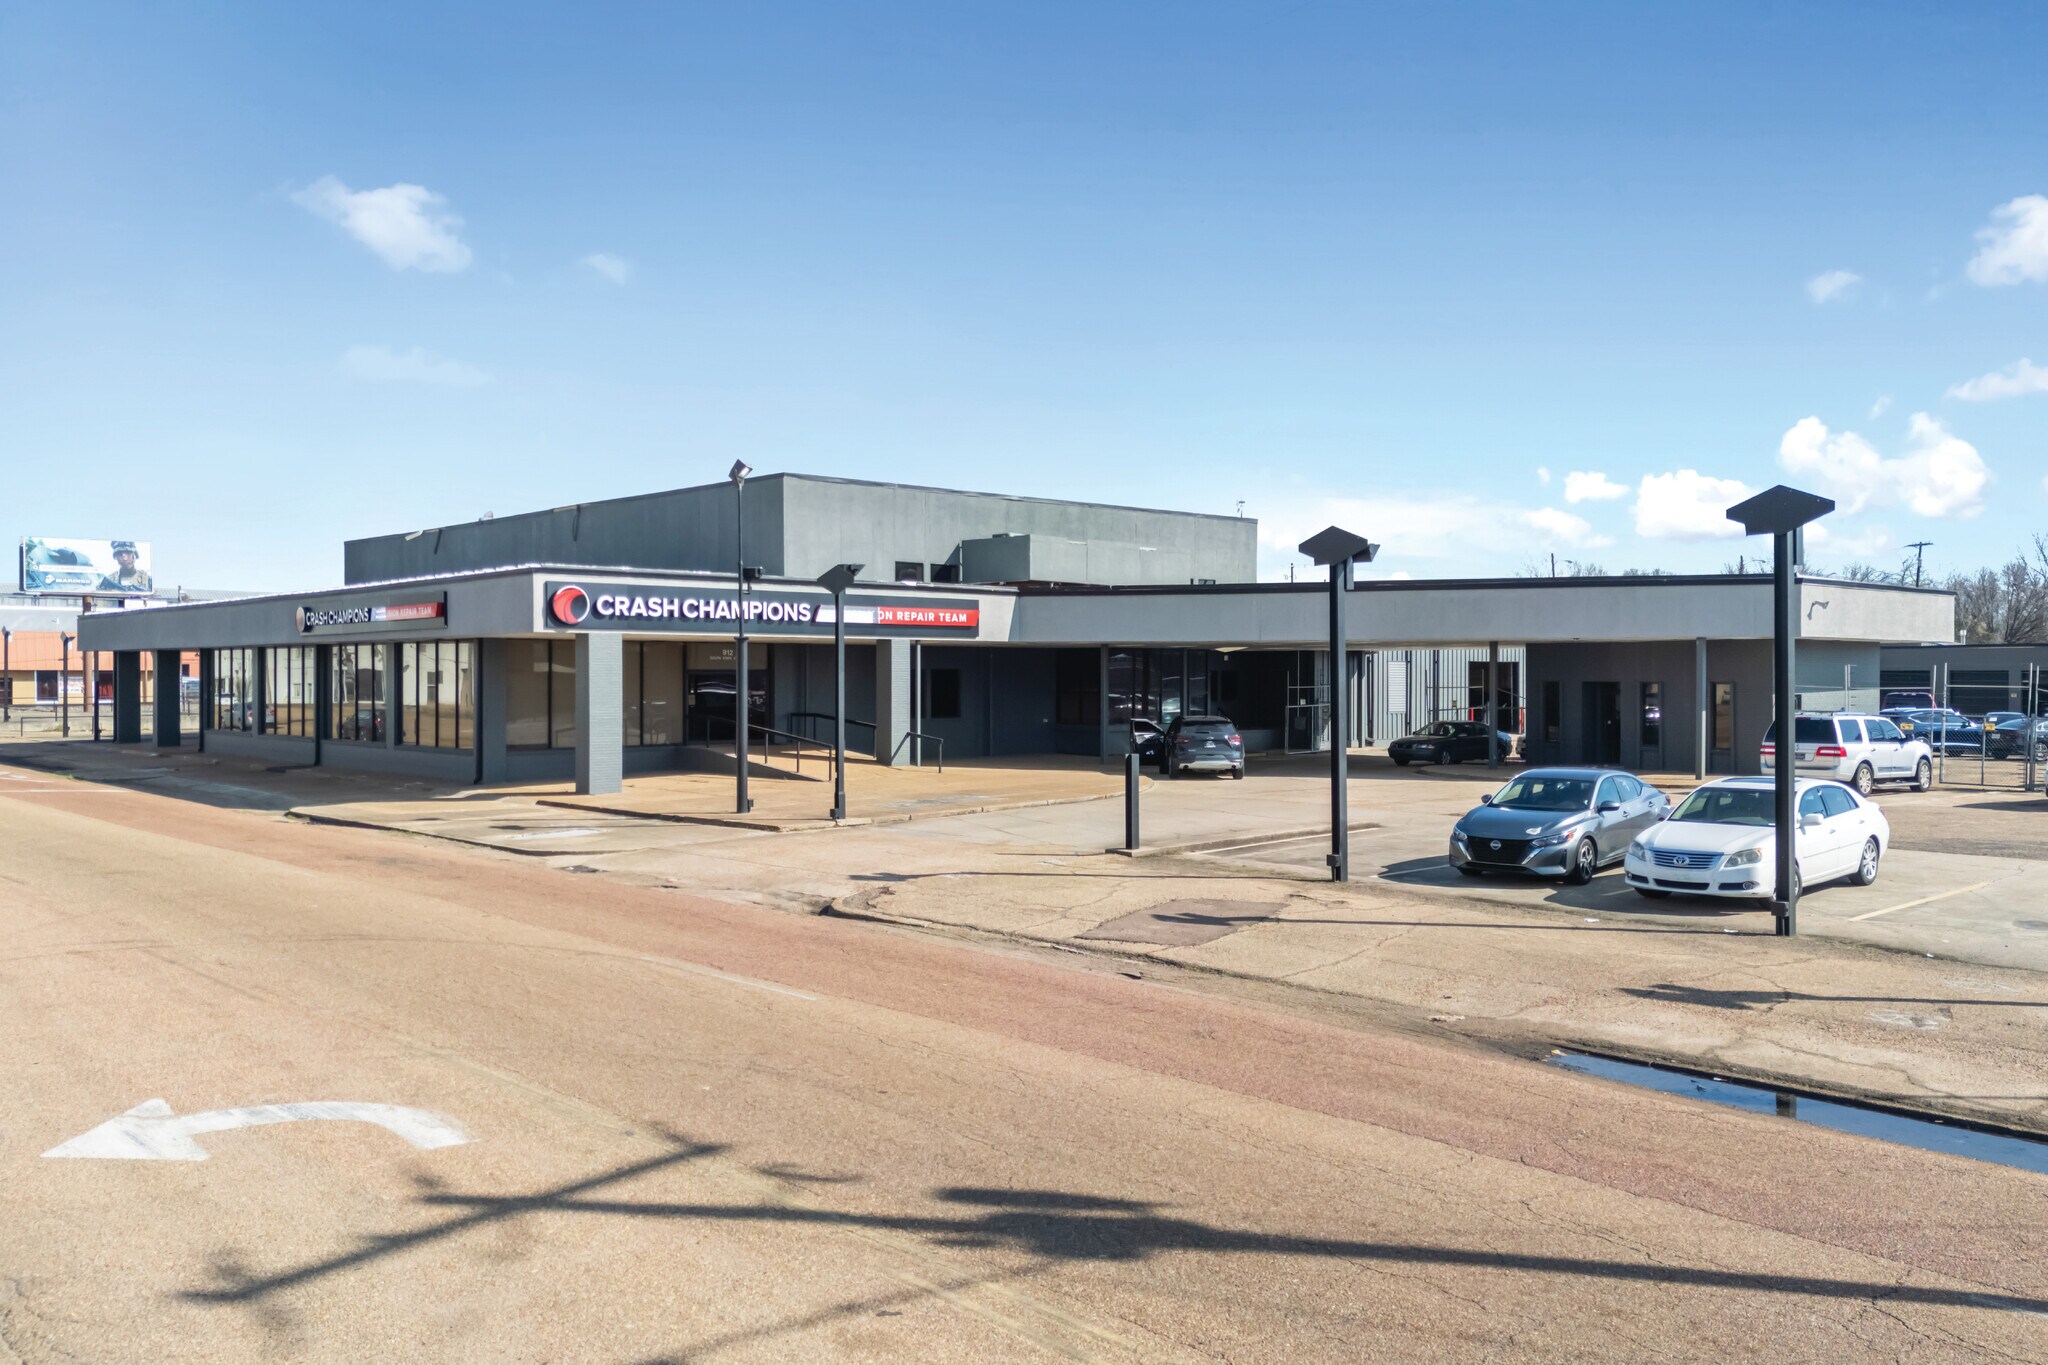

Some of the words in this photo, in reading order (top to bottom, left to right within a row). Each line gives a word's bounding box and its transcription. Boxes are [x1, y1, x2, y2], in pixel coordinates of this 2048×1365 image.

[305, 611, 328, 626] CRASH
[328, 607, 369, 625] CHAMPIONS
[595, 595, 679, 618] CRASH
[682, 599, 811, 622] CHAMPIONS
[896, 611, 935, 622] REPAIR
[938, 613, 967, 623] TEAM
